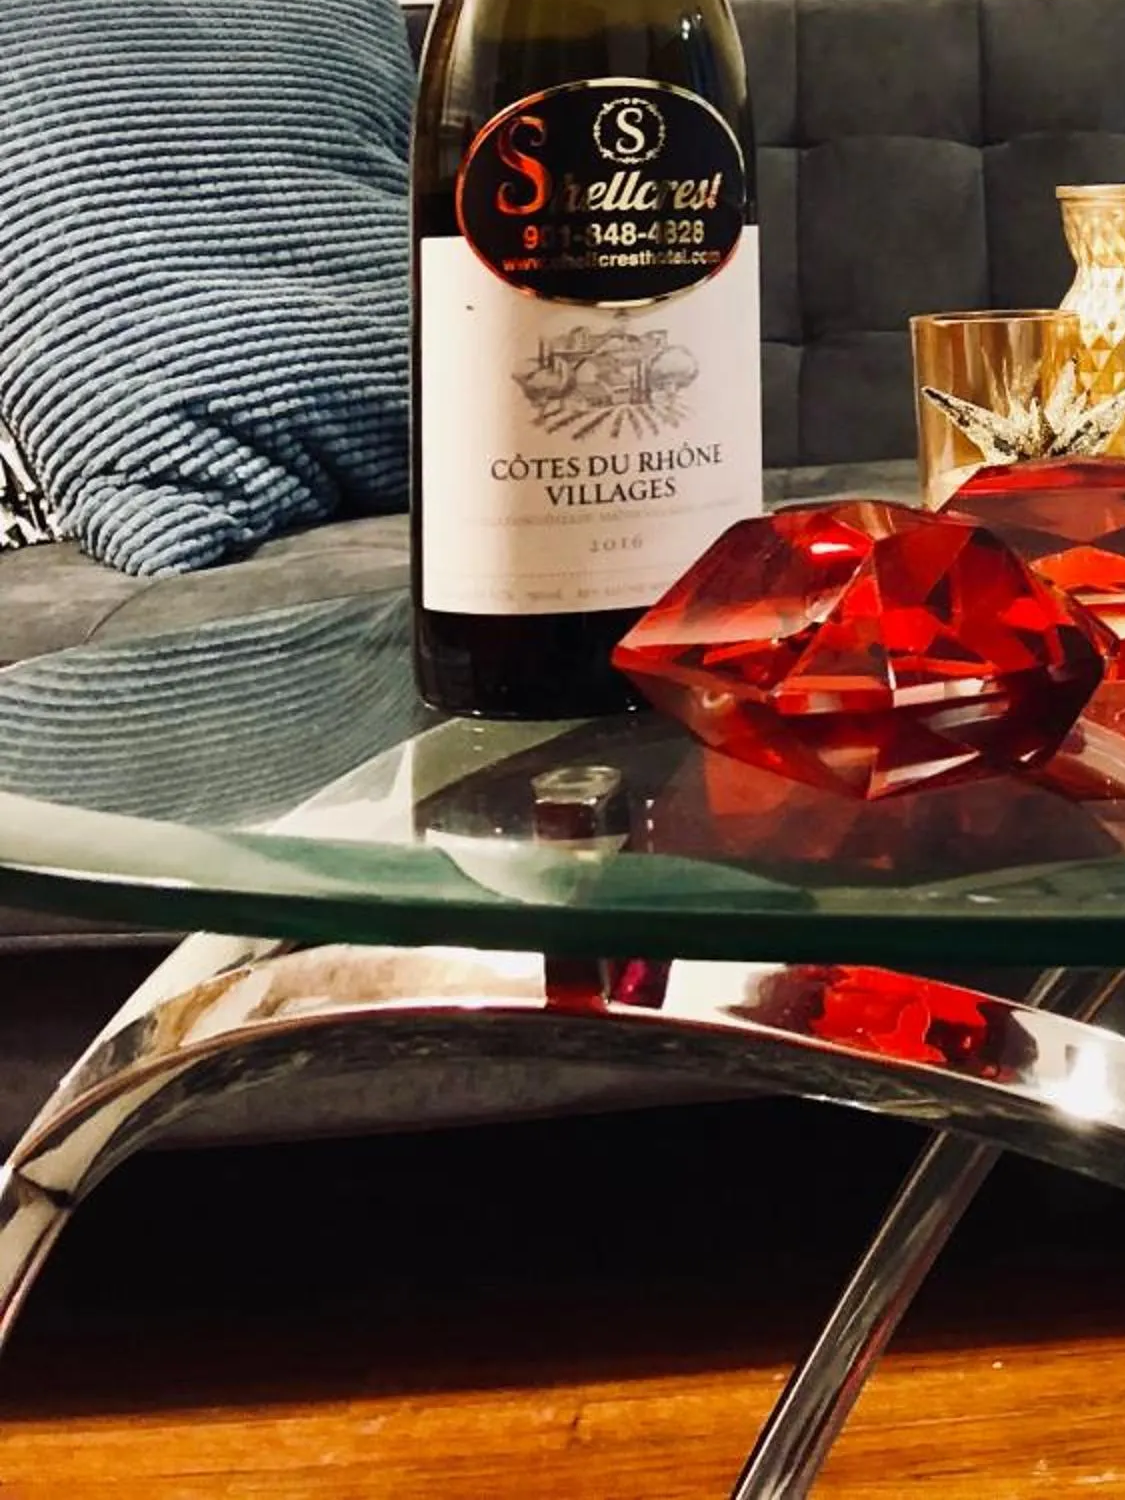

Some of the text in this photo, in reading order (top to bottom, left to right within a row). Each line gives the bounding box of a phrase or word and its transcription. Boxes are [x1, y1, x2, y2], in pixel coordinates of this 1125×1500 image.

[491, 442, 722, 482] CÔTES DU RHÔNE
[546, 476, 676, 506] VILLAGES
[590, 534, 644, 553] 2016
